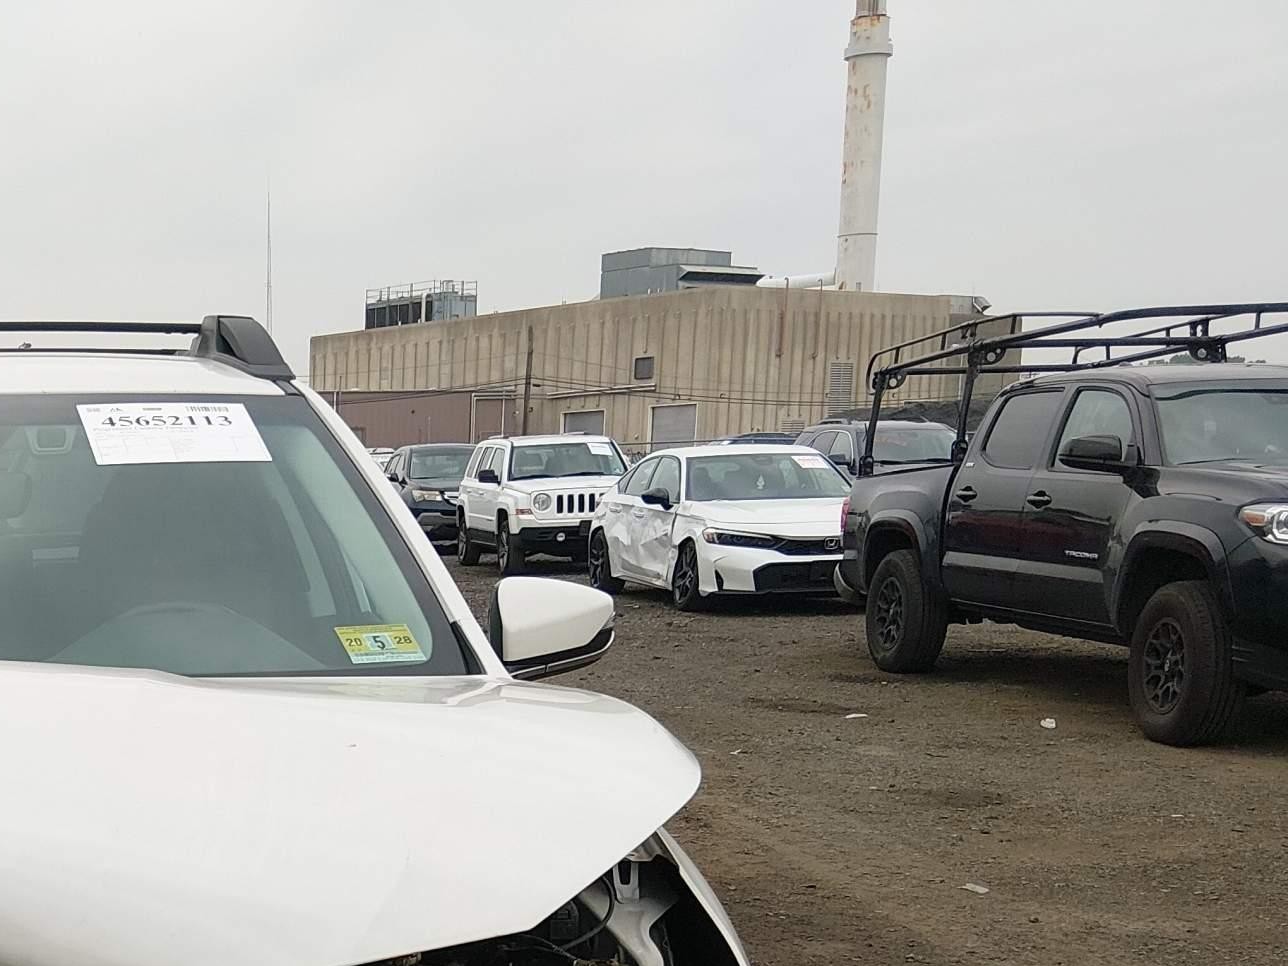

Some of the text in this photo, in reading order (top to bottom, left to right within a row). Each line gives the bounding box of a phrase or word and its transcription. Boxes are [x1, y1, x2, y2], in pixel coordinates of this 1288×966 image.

[101, 415, 233, 427] 45652113
[1063, 550, 1098, 560] TACOMA
[346, 635, 412, 650] 20 5 28
